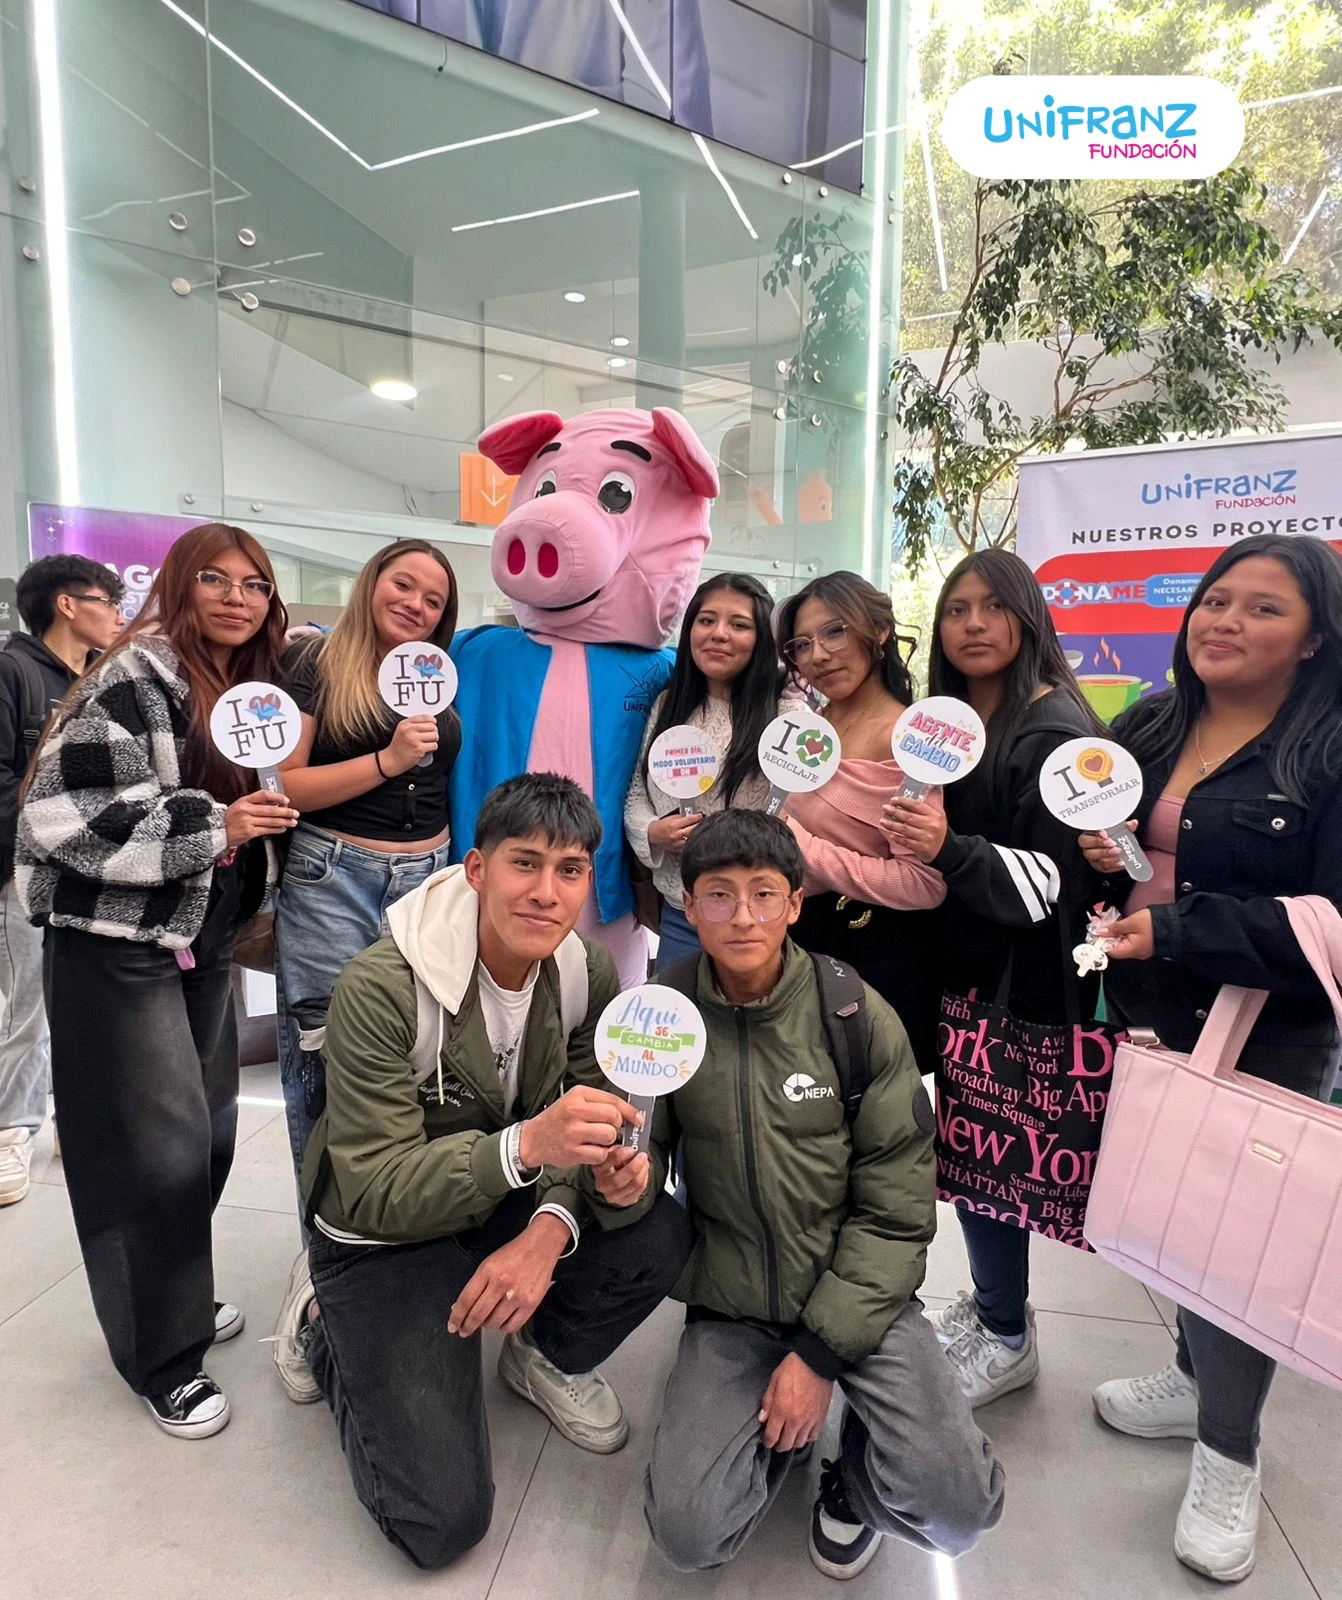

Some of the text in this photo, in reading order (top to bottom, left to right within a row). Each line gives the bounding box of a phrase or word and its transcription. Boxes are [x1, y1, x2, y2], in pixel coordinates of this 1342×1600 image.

[1072, 515, 1342, 545] NUESTROS PROYECT
[1043, 581, 1147, 606] DONAME
[394, 654, 411, 680] I
[392, 680, 445, 707] FU
[226, 698, 248, 729] I
[229, 720, 288, 759] FU
[771, 719, 800, 756] I
[908, 711, 976, 752] AGENTE
[653, 756, 716, 768] MODO VOLUNTARIO
[665, 747, 689, 756] PRIMER
[899, 733, 961, 773] CAMBIO
[680, 768, 690, 776] ON
[763, 751, 819, 784] RECICLAJE
[1053, 765, 1086, 801] I
[1058, 777, 1140, 819] TRANSFORMAR
[941, 995, 971, 1020] Fifth
[627, 1035, 673, 1049] CAMBIA
[655, 1026, 669, 1037] SE
[641, 1050, 655, 1061] AL
[1027, 1055, 1058, 1075] York
[943, 1059, 1023, 1108] Broadway
[960, 1088, 1045, 1132] Times Square
[1025, 1075, 1110, 1122] Big Ap
[935, 1086, 1017, 1166] New
[1008, 1172, 1046, 1196] Statue
[1049, 1185, 1063, 1197] of
[1040, 1200, 1074, 1226] Big
